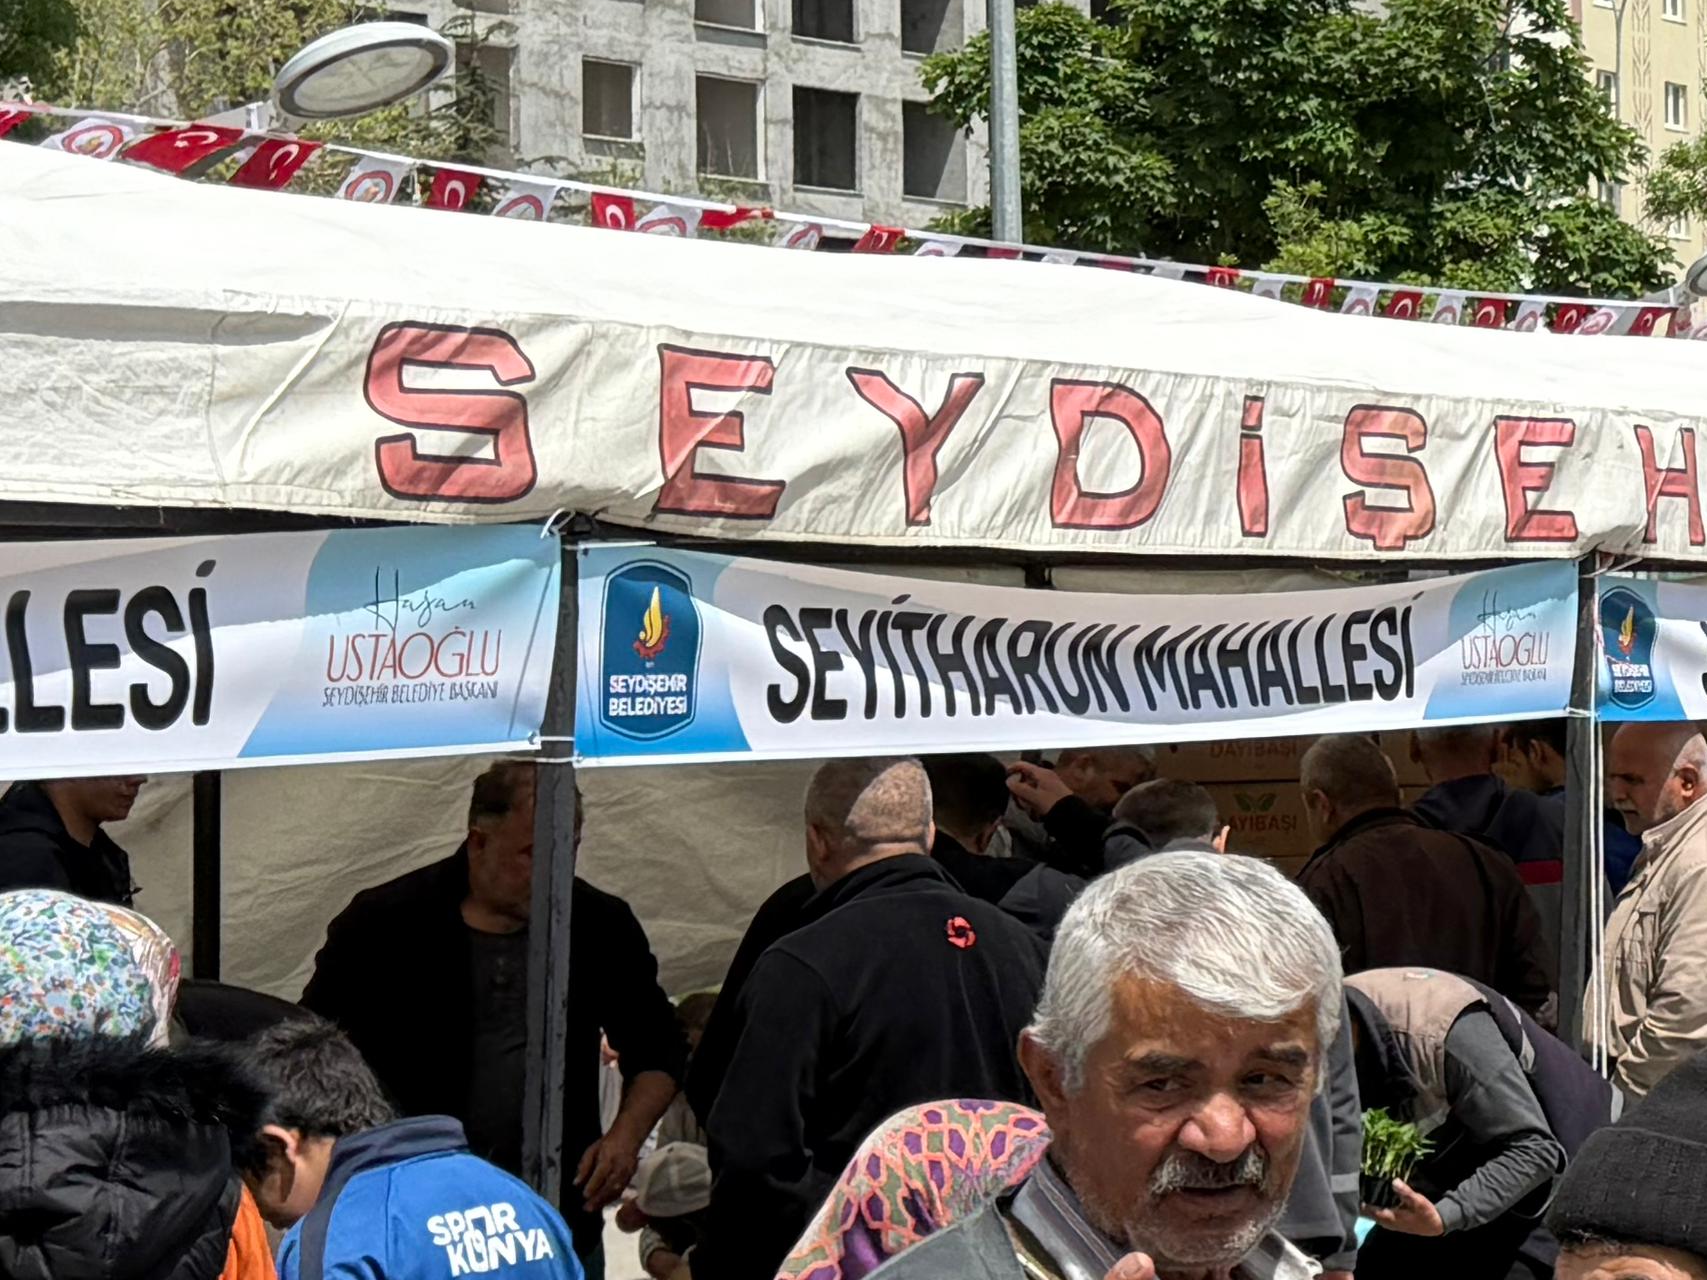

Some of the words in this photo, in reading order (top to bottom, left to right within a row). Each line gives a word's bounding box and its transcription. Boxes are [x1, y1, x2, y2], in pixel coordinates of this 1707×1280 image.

[326, 626, 502, 684] USTAOĞLU
[764, 593, 1146, 724] SEYİTHARUN
[1132, 592, 1424, 712] MAHALLESİ
[608, 696, 688, 717] BELEDİYESİ
[609, 673, 688, 697] SEYDİŞEHİR
[1228, 812, 1297, 833] AYIBAŞI
[426, 1202, 521, 1246] SPOR
[446, 1228, 554, 1277] KONYA
